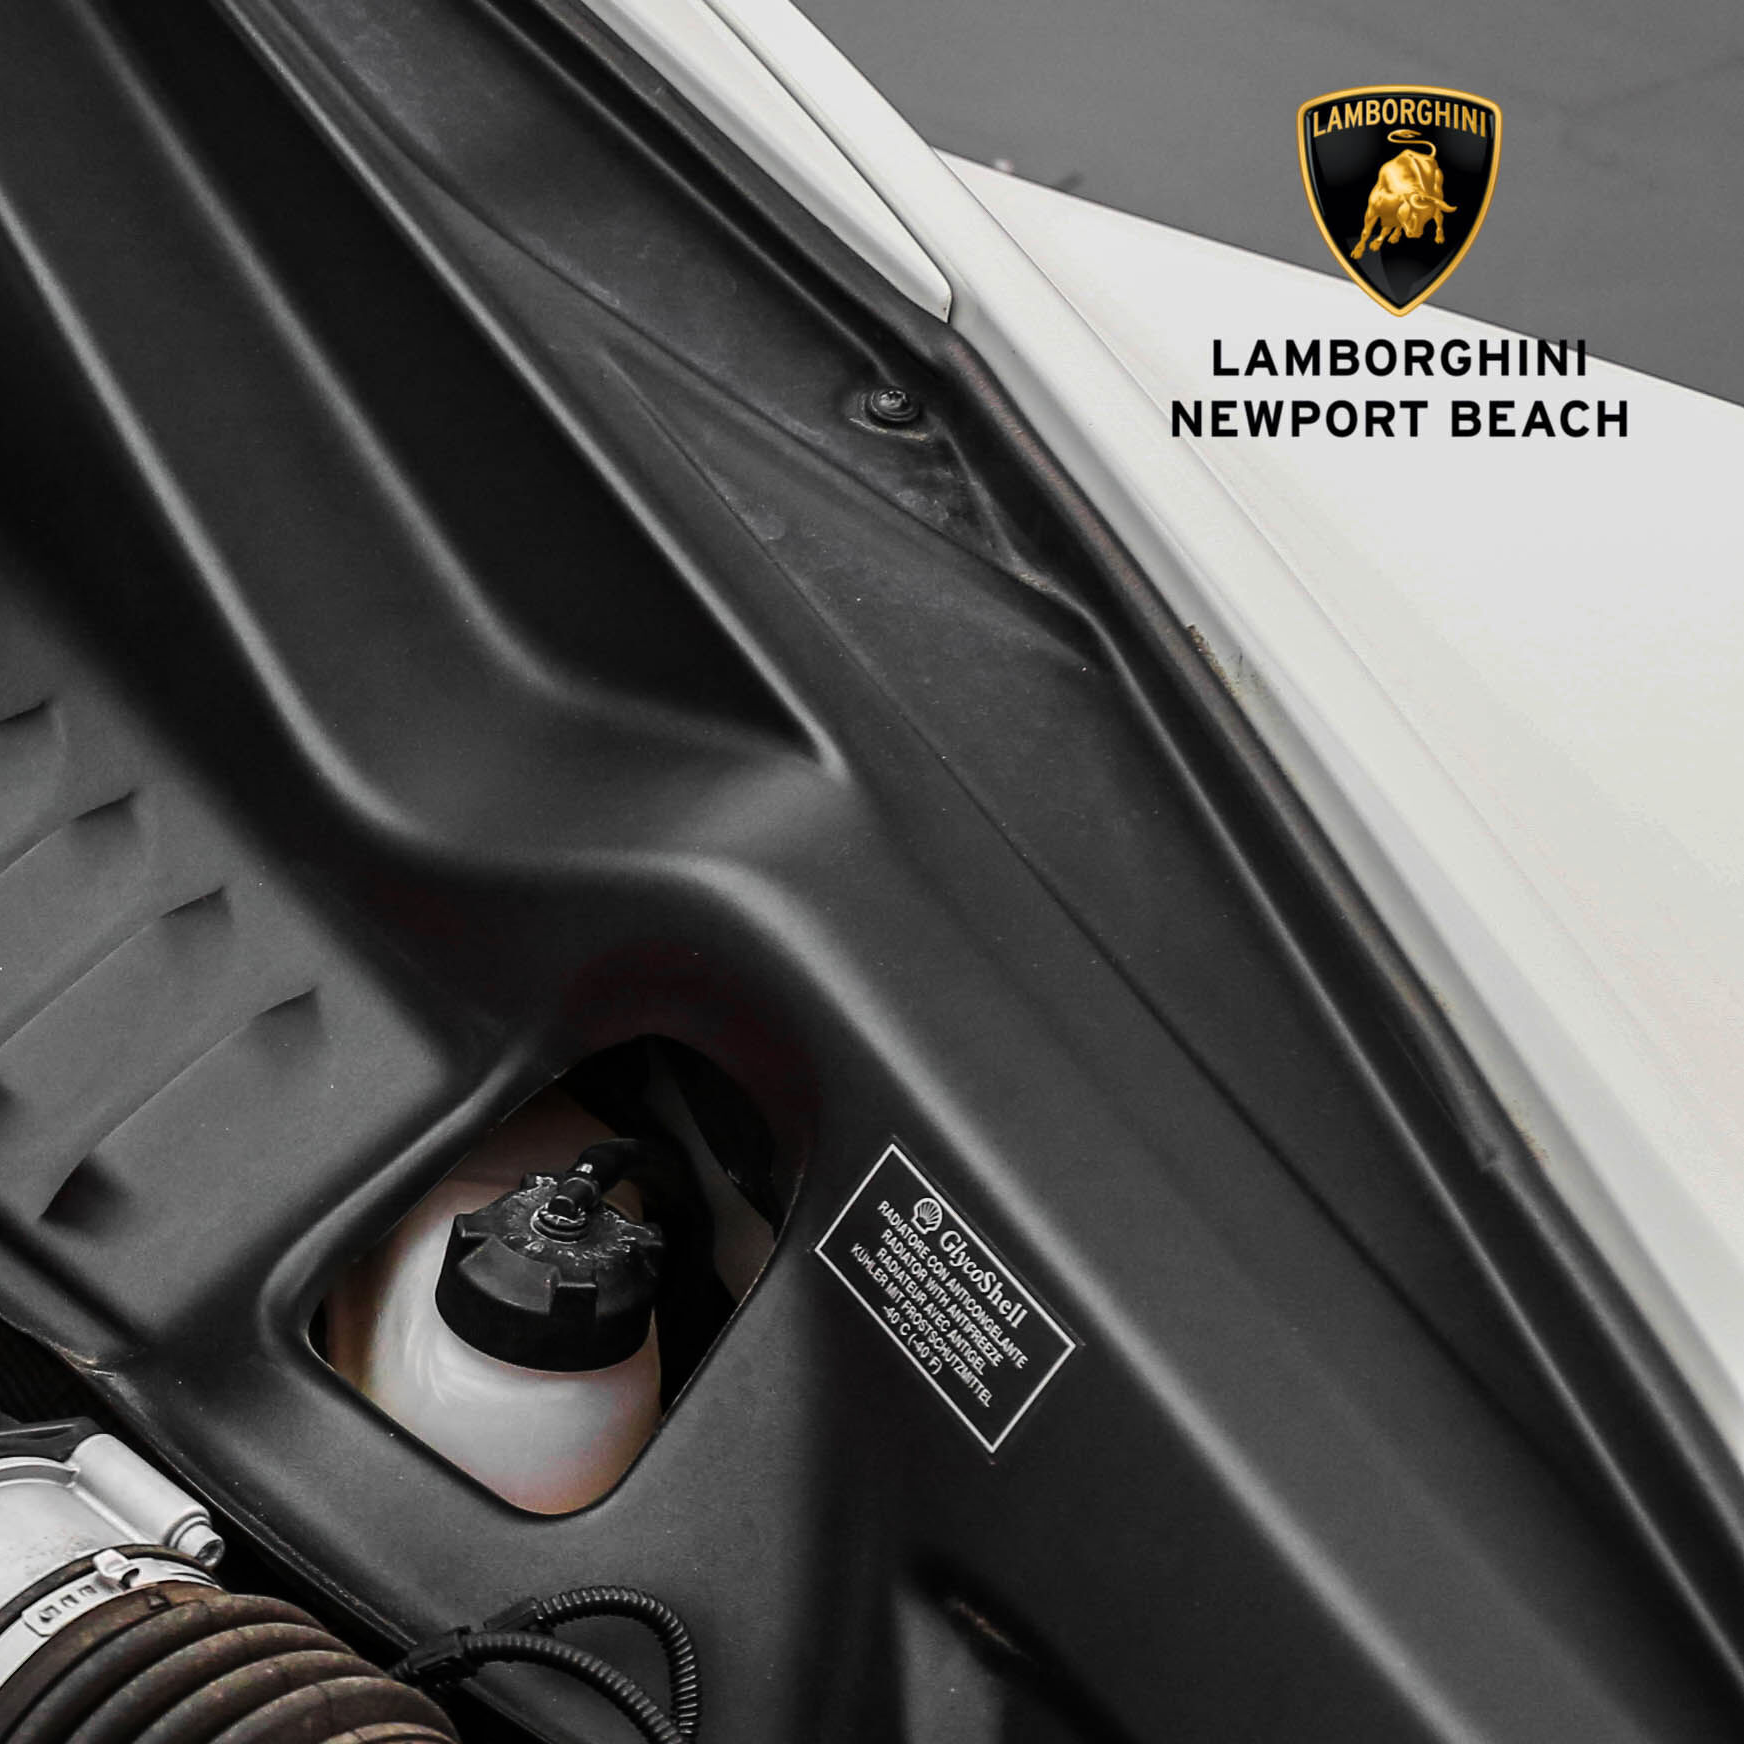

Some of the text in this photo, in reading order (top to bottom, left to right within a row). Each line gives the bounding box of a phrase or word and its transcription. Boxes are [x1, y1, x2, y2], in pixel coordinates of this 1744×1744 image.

[876, 1248, 986, 1376] RADIATEUR AVEC ANTIGEL
[877, 1200, 1029, 1369] RADIATORE CON ANTICONGELANTE
[881, 1229, 1004, 1367] RADIATOR WITH ANTIFREEZE
[940, 1230, 1028, 1329] GlycoShell
[885, 1282, 905, 1304] MIT
[901, 1300, 992, 1408] FROSTSCHUTZMITTEL
